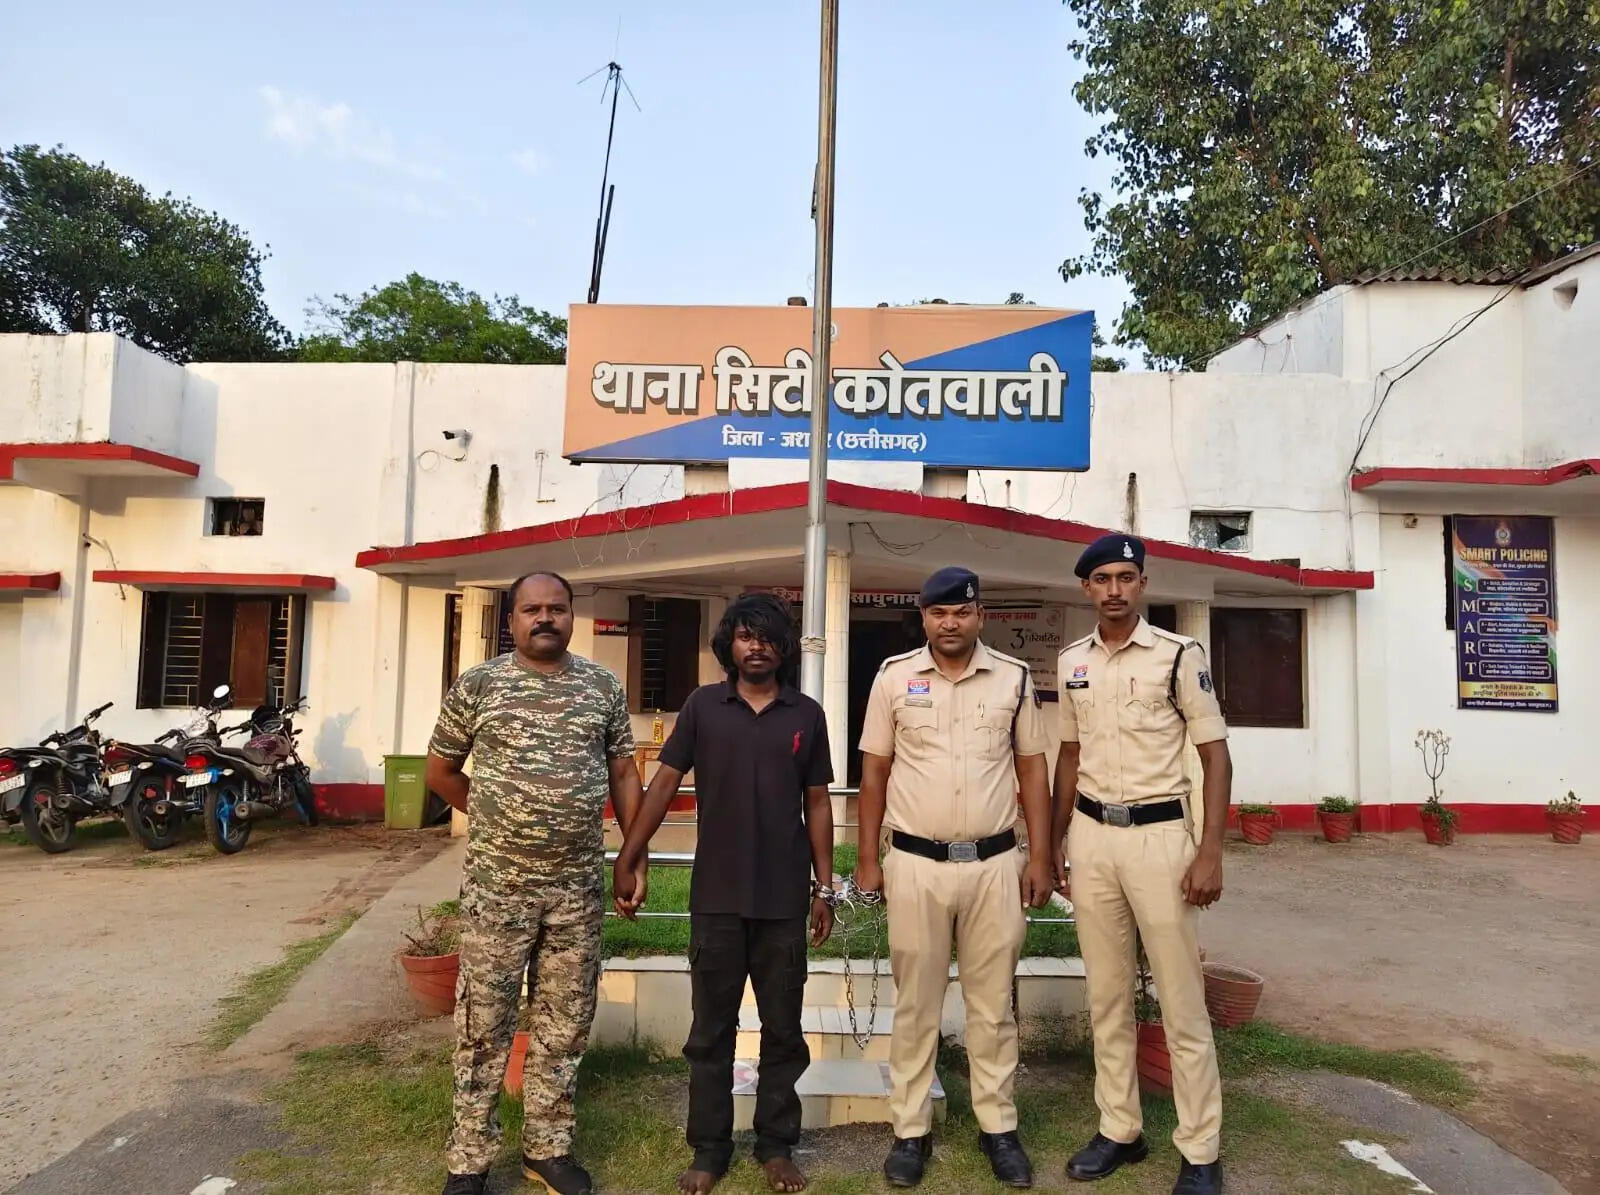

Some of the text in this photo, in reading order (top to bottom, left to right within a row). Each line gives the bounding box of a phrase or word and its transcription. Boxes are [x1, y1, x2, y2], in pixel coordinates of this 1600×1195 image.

[591, 346, 1067, 420] थाना सिटी कोतवाली
[722, 424, 764, 446] जिला
[836, 428, 928, 453] (छत्तीसगढ़)
[1460, 547, 1548, 562] SMART POLICING
[1463, 579, 1473, 592] S
[1461, 600, 1477, 613] M
[1464, 620, 1475, 633] A
[1465, 642, 1476, 654] R
[1465, 662, 1477, 675] T
